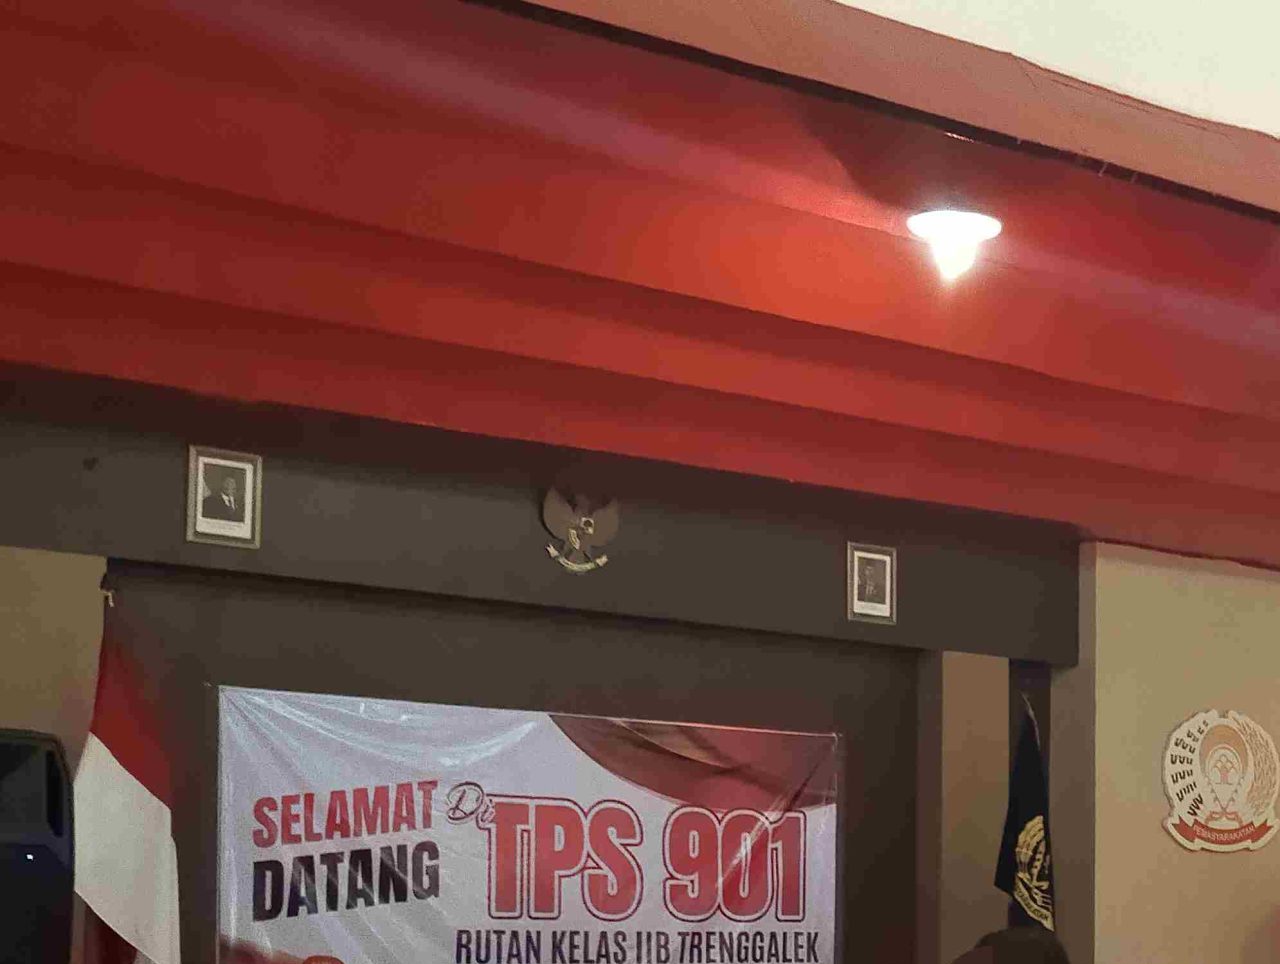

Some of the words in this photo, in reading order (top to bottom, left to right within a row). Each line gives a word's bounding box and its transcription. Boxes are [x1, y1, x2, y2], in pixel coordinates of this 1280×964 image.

[253, 780, 438, 848] SELAMAT
[252, 841, 440, 922] DATANG
[488, 795, 643, 920] TPS
[664, 806, 806, 922] 901
[455, 929, 542, 964] RUTAN
[551, 930, 627, 964] KELAS
[635, 931, 670, 964] IIB
[678, 931, 820, 964] TRENGGALEK
